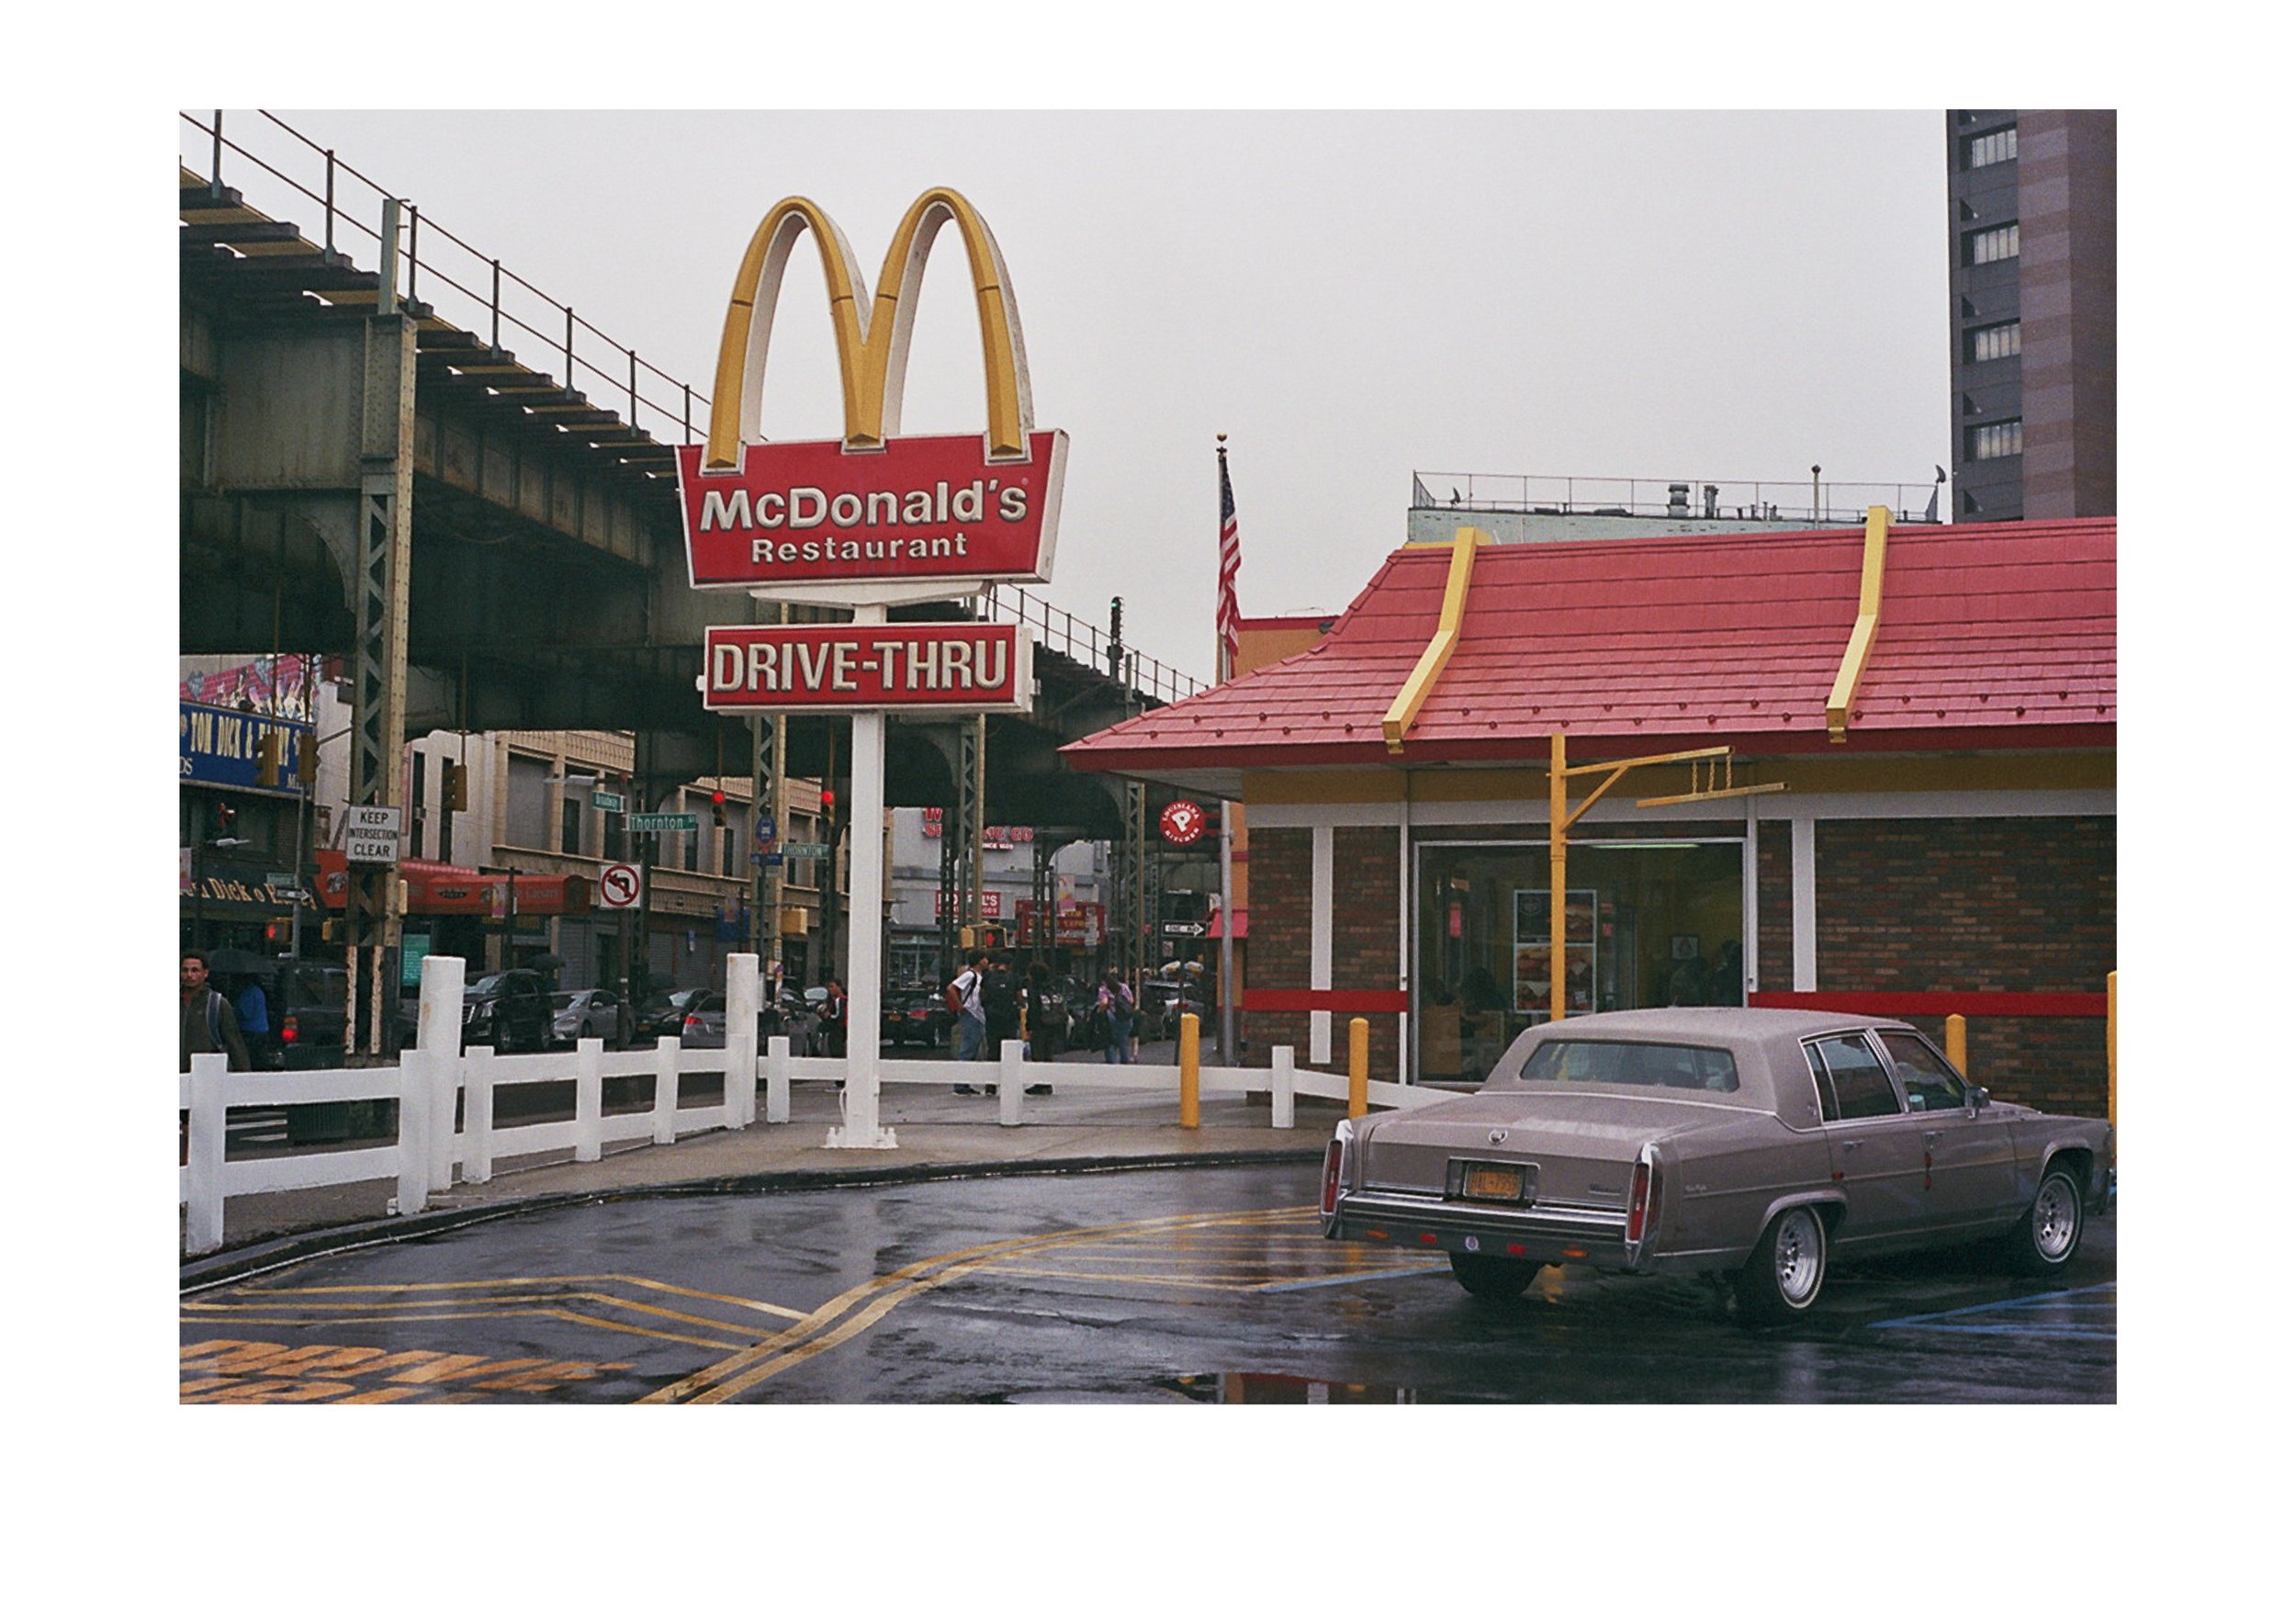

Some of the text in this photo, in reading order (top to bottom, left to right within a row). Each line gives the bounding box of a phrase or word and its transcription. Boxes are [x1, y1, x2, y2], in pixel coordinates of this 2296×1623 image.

[700, 479, 1028, 532] McDonald's
[751, 532, 967, 563] Restaurant
[712, 638, 1007, 693] DRIVE-THRU
[360, 811, 388, 825] KEEP
[631, 817, 683, 829] Thornton
[349, 828, 399, 840] INTERSECTION
[354, 843, 390, 857] CLEAR
[208, 877, 253, 902] Dick
